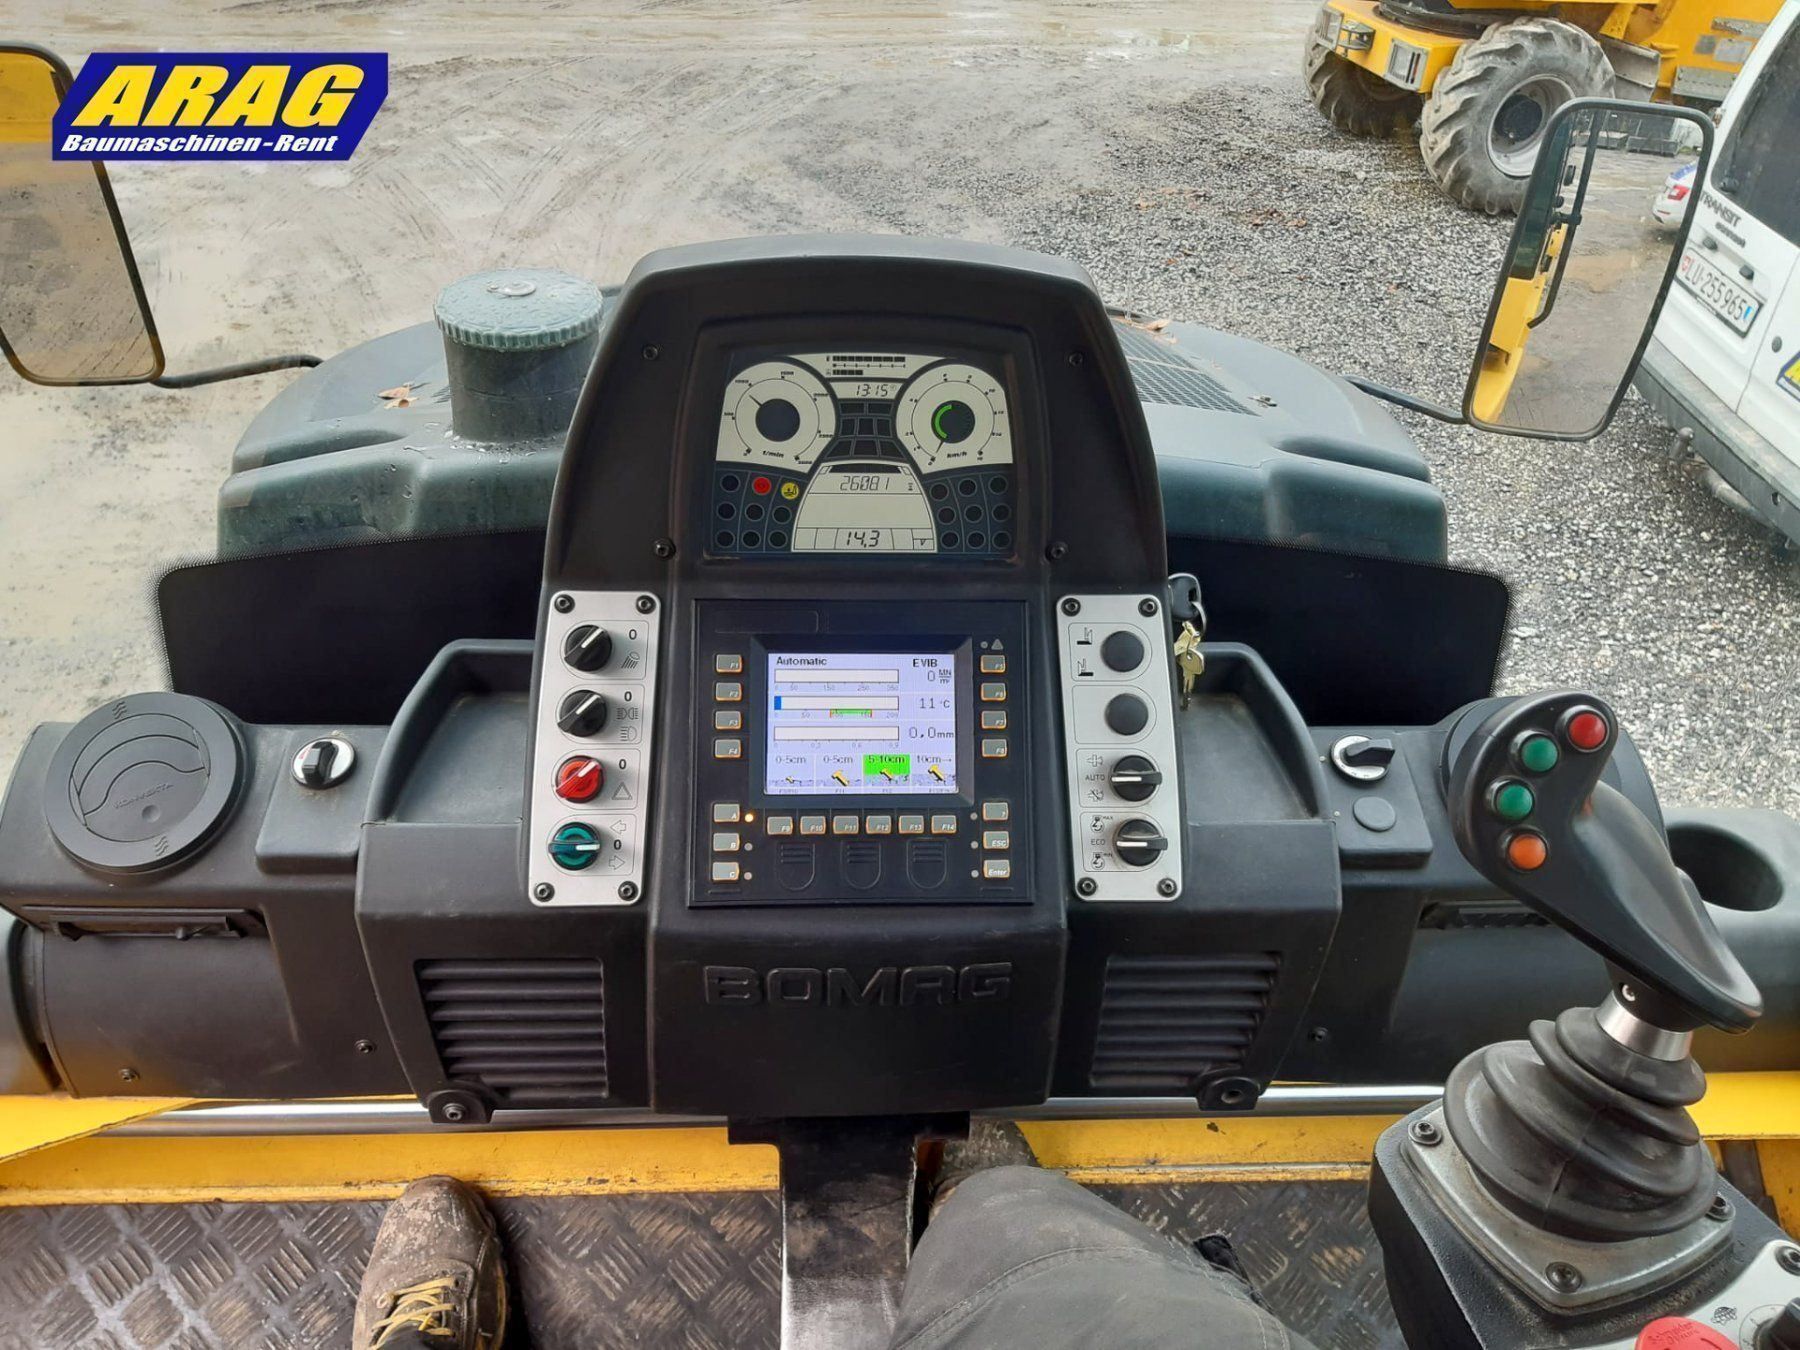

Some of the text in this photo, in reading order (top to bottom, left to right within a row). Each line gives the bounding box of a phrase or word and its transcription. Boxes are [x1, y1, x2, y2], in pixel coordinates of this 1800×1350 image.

[1699, 191, 1742, 228] TRANSIT
[856, 383, 889, 398] 13:15
[628, 629, 638, 640] 0
[776, 656, 828, 666] Automatic
[623, 691, 633, 702] 0
[618, 759, 627, 770] 0
[776, 755, 807, 765] 0-5cm
[823, 755, 854, 765] 0-5cm
[613, 840, 622, 850] 0
[991, 839, 1007, 847] ESC
[1090, 838, 1106, 846] ECO
[988, 868, 1007, 876] Enter
[702, 962, 1012, 1005] BOMAG
